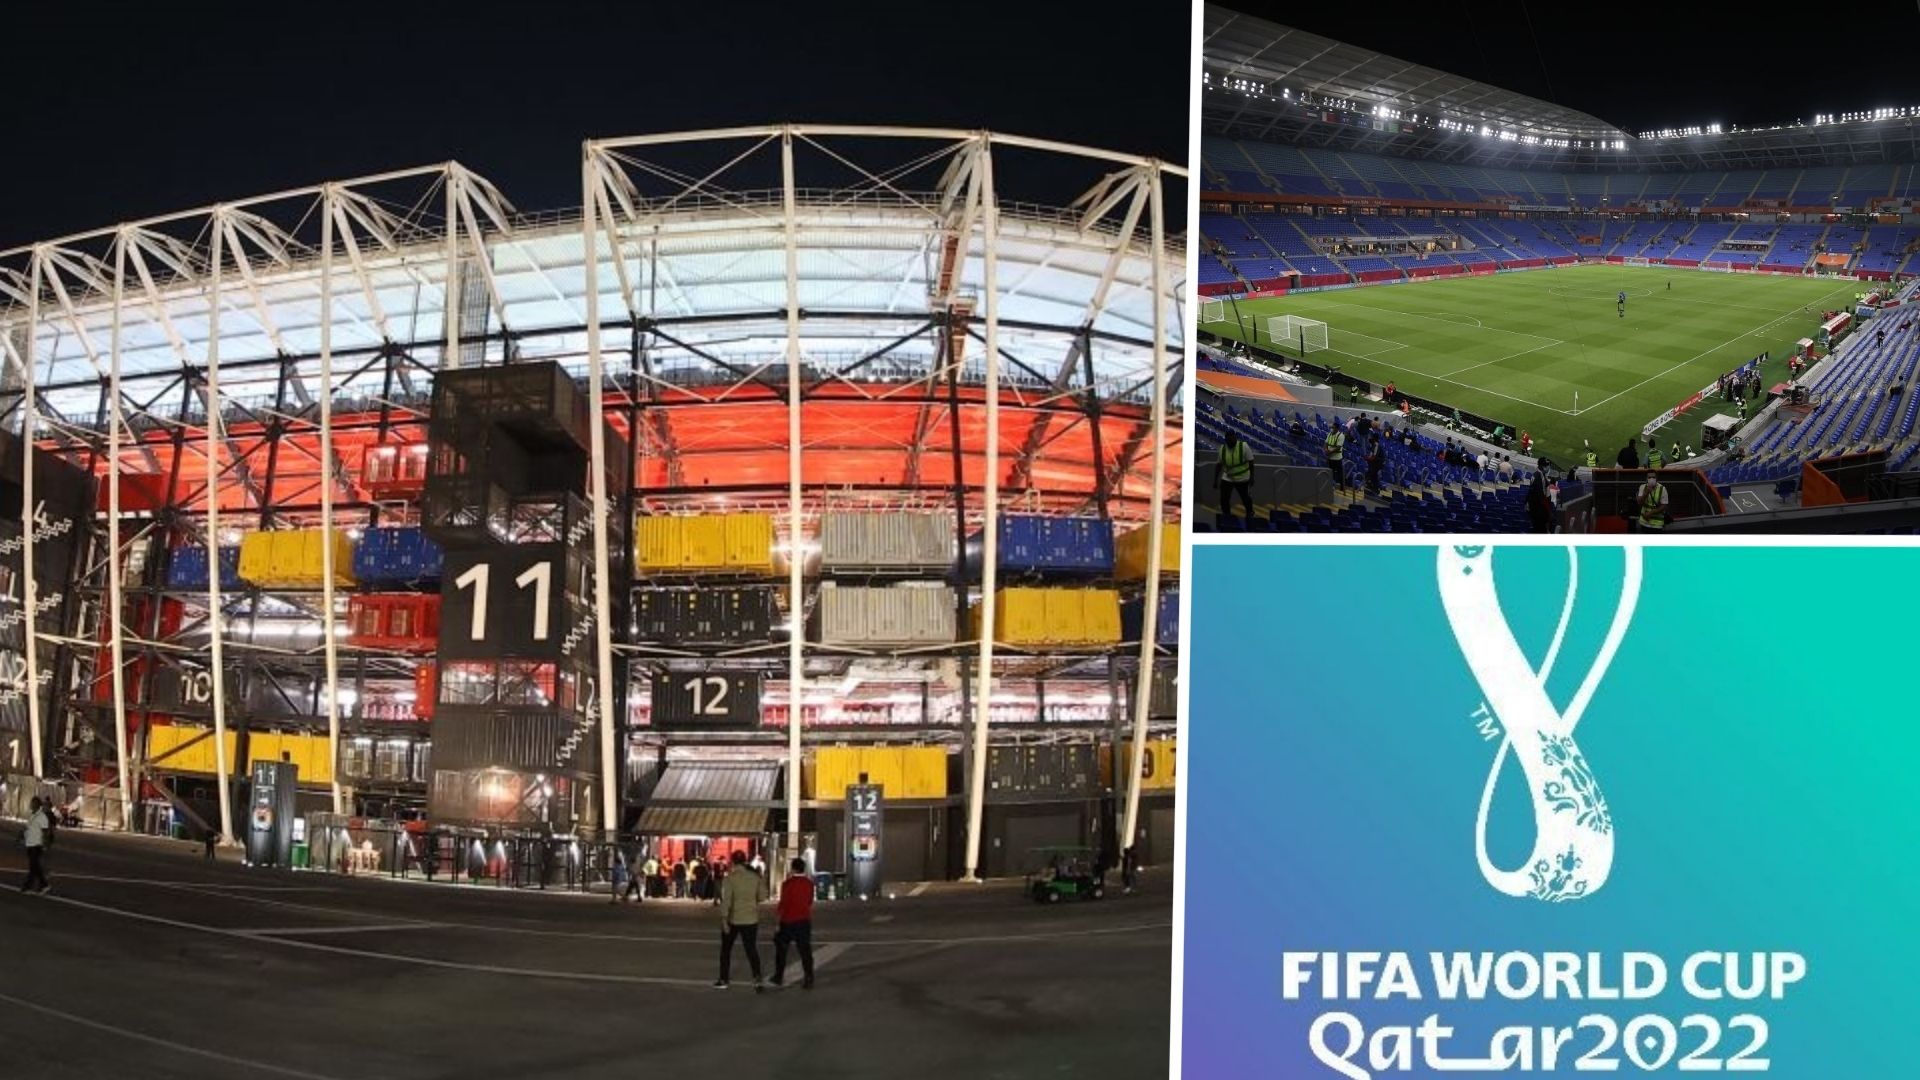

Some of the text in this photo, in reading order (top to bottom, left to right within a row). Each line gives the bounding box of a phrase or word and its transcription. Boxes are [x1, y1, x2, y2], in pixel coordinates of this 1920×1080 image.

[455, 562, 551, 640] 11
[181, 669, 212, 703] 10
[685, 677, 728, 715] 12
[1470, 702, 1500, 742] TM
[256, 768, 276, 786] 11
[853, 791, 878, 811] 12
[1283, 950, 1807, 1000] FIFA WORLD CUP
